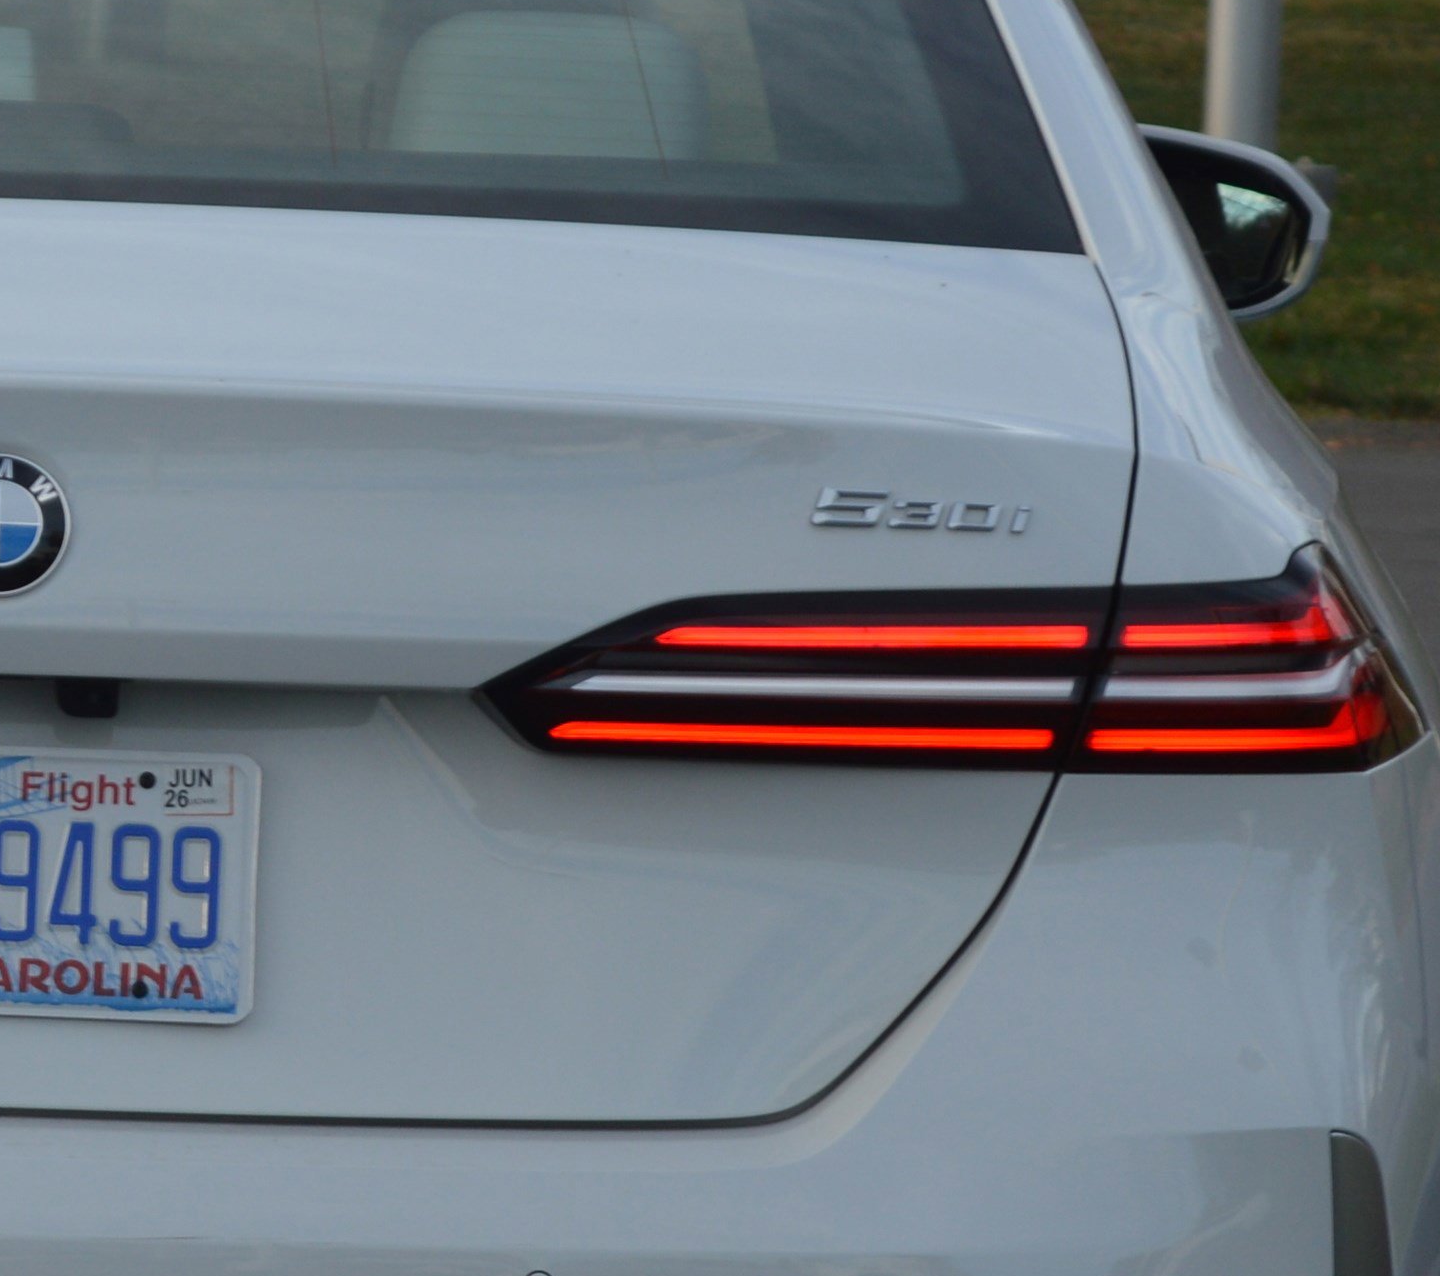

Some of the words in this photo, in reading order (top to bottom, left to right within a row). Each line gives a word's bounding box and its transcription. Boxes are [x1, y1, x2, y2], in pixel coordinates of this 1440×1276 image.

[810, 487, 1031, 533] 530i
[22, 771, 136, 812] Flight
[168, 768, 213, 788] JUN
[164, 789, 189, 808] 26
